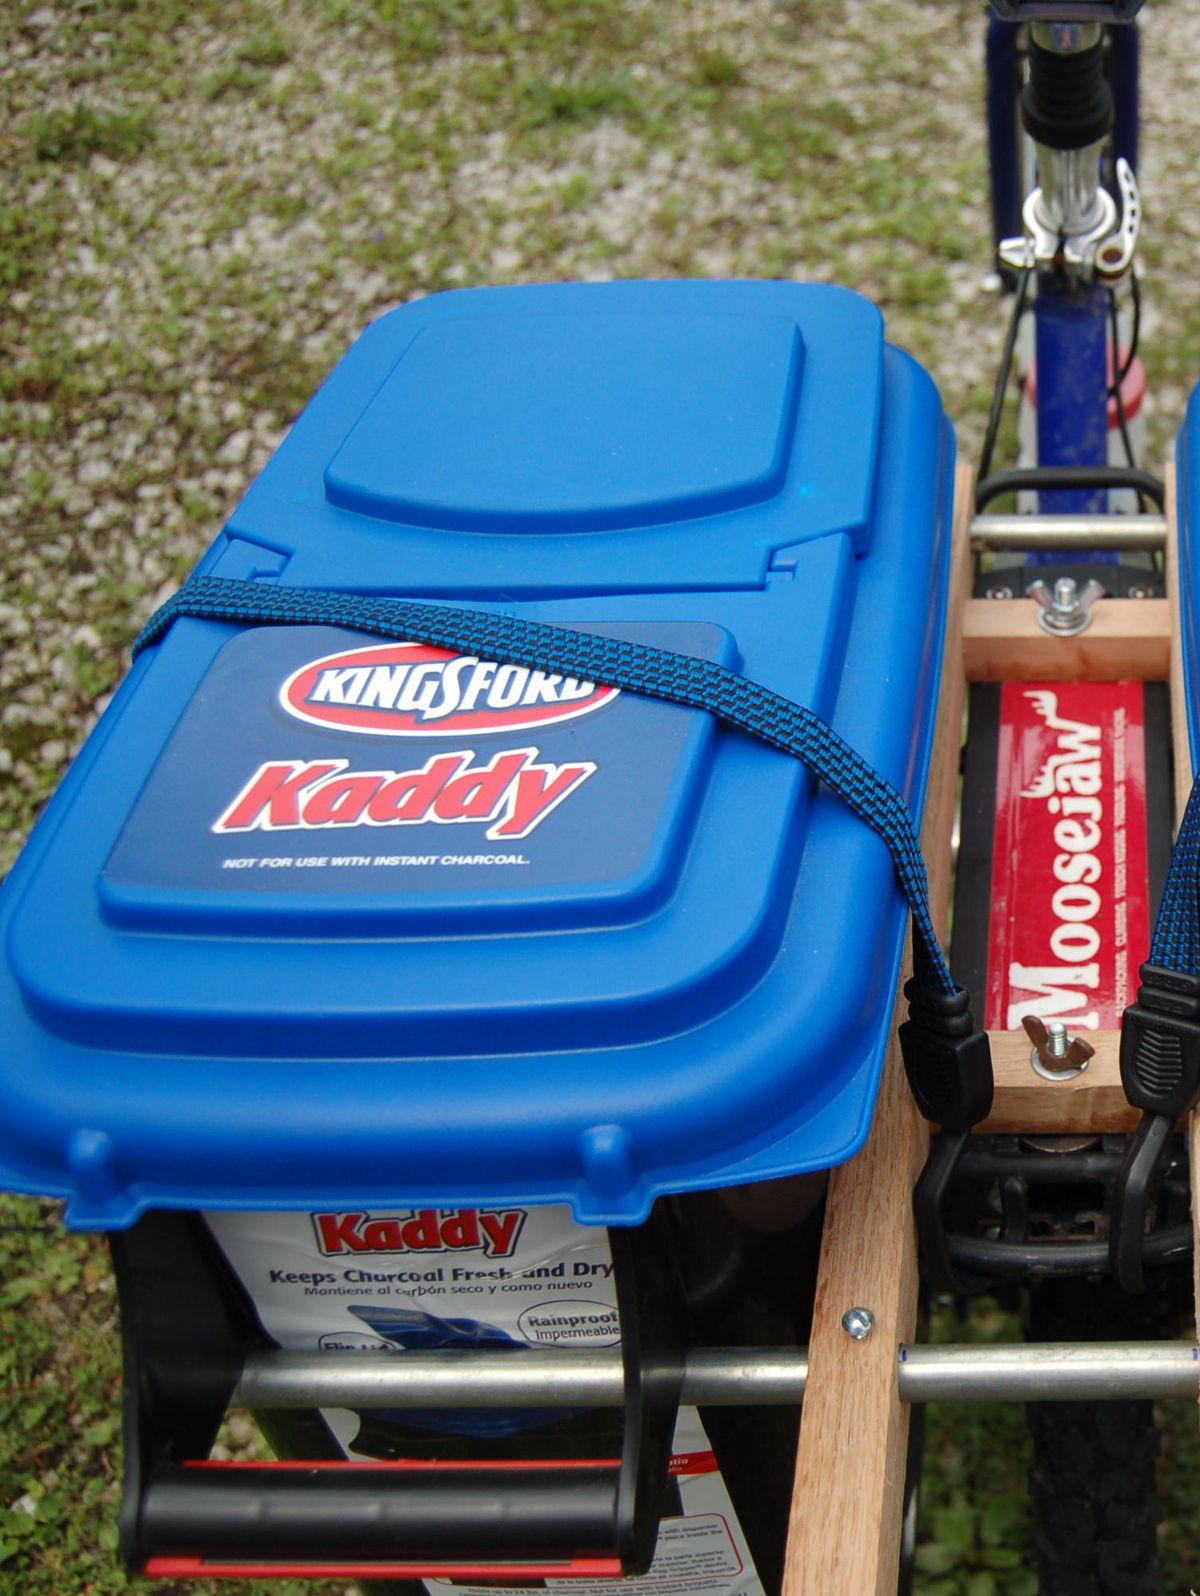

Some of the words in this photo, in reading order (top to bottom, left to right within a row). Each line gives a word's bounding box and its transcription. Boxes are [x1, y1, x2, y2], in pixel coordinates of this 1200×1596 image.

[211, 747, 597, 841] Kaddy
[222, 858, 257, 869] NOT
[259, 857, 293, 868] FOR
[296, 857, 328, 867] USE
[331, 856, 370, 867] WITH
[373, 855, 439, 866] INSTANT
[440, 854, 530, 865] CHARCOAL.
[1006, 690, 1102, 1030] Moosejaw
[312, 1209, 527, 1258] Kaddy
[269, 1269, 336, 1285] Keeps
[344, 1266, 443, 1283] Charcoal
[452, 1267, 512, 1282] Fresh
[521, 1262, 566, 1279] and
[573, 1261, 615, 1281] Dry
[304, 1285, 373, 1297] Mantiene
[377, 1284, 391, 1296] al
[451, 1285, 484, 1295] seco
[488, 1286, 497, 1296] y
[501, 1282, 543, 1293] como
[547, 1279, 594, 1290] nuevo
[527, 1310, 618, 1329] Rainproof
[536, 1325, 620, 1341] Impermeable
